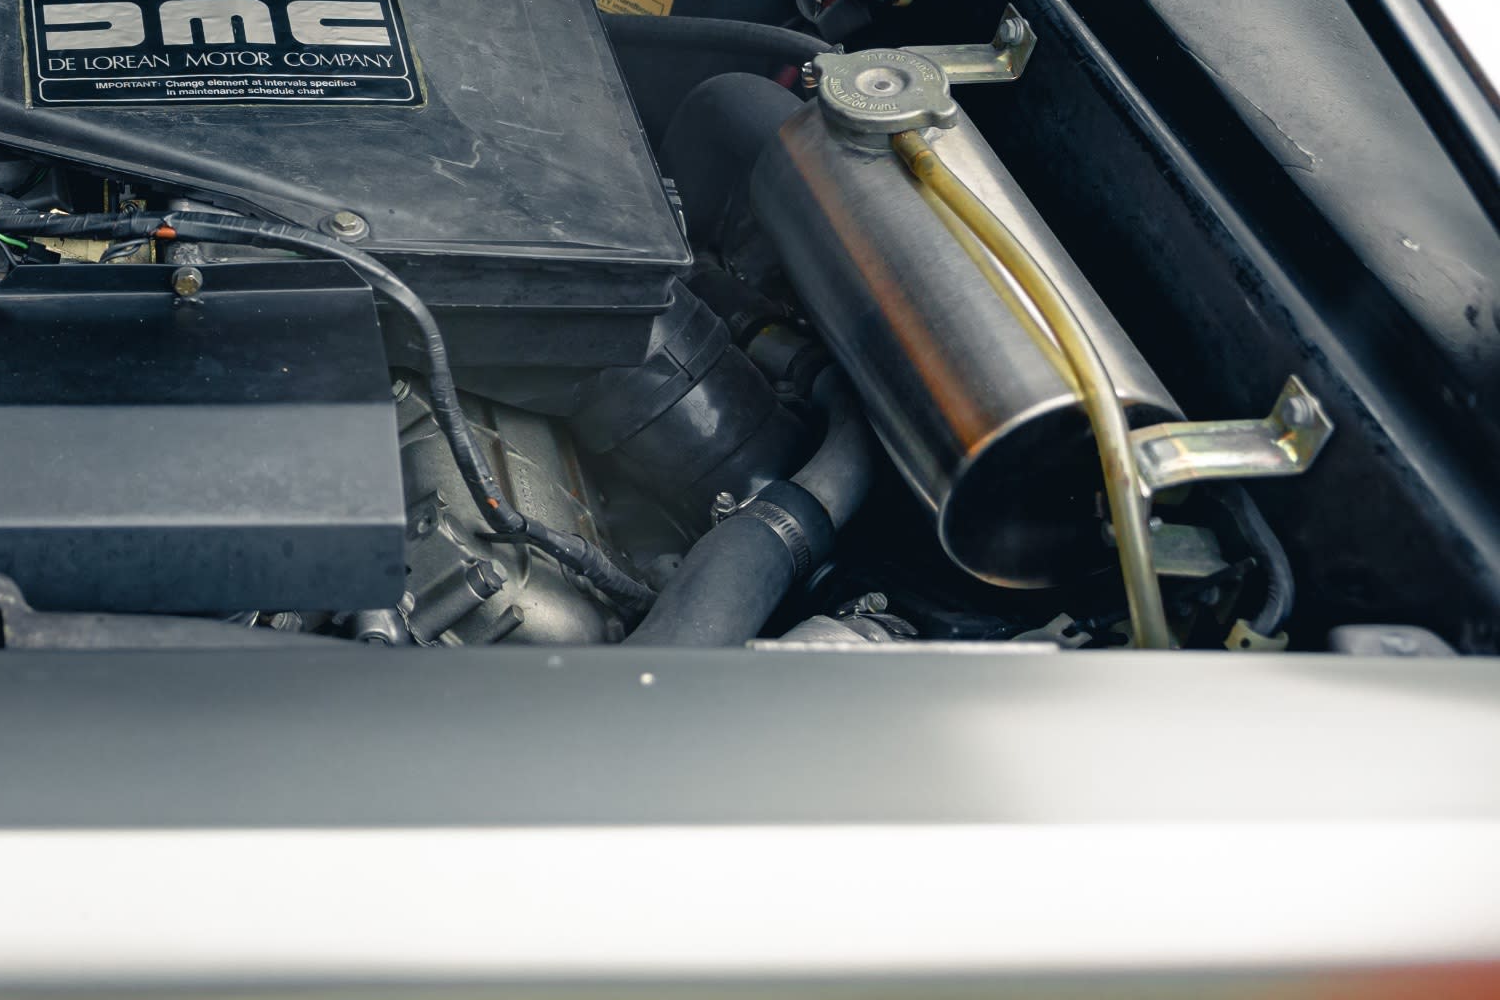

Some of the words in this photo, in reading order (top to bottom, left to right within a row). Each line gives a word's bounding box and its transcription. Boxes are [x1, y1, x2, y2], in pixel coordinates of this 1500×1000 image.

[48, 57, 77, 72] DE
[84, 53, 170, 70] LOREAN
[185, 51, 273, 68] MOTOR
[284, 51, 394, 69] COMPANY
[95, 81, 161, 89] IMPORTANT:
[165, 80, 205, 88] Change
[264, 79, 307, 87] intervals
[309, 80, 357, 88] specified
[179, 88, 245, 96] maintenance
[247, 87, 295, 95] schedule
